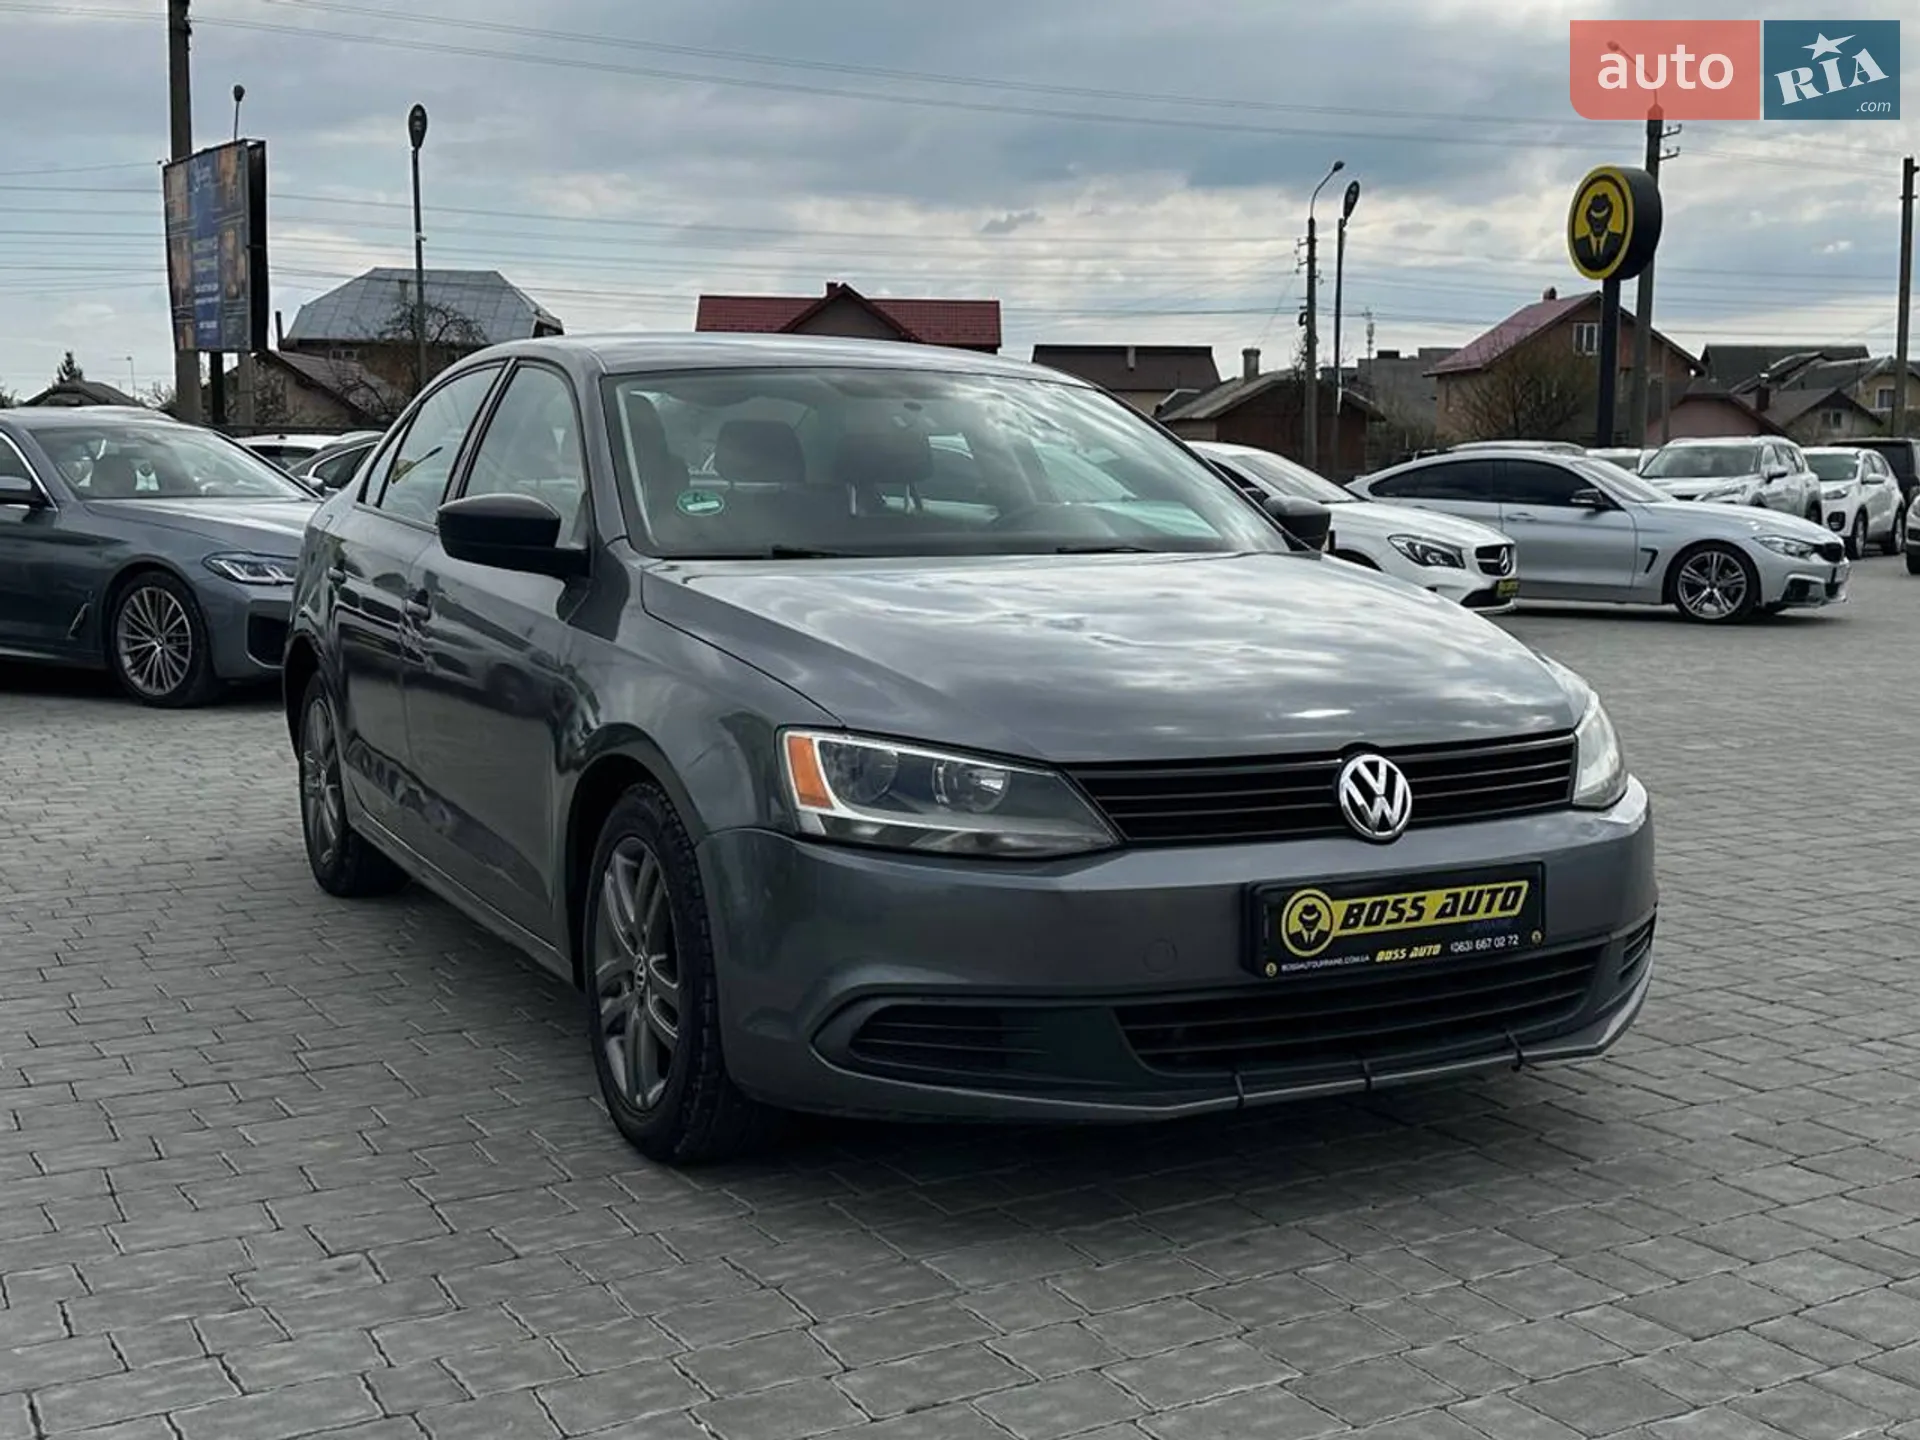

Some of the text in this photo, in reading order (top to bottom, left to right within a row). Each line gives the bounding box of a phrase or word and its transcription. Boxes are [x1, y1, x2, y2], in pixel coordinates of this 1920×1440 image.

[1338, 896, 1428, 930] BOSS
[1435, 886, 1523, 919] AUTO
[1375, 944, 1442, 962] BOSS AUTO
